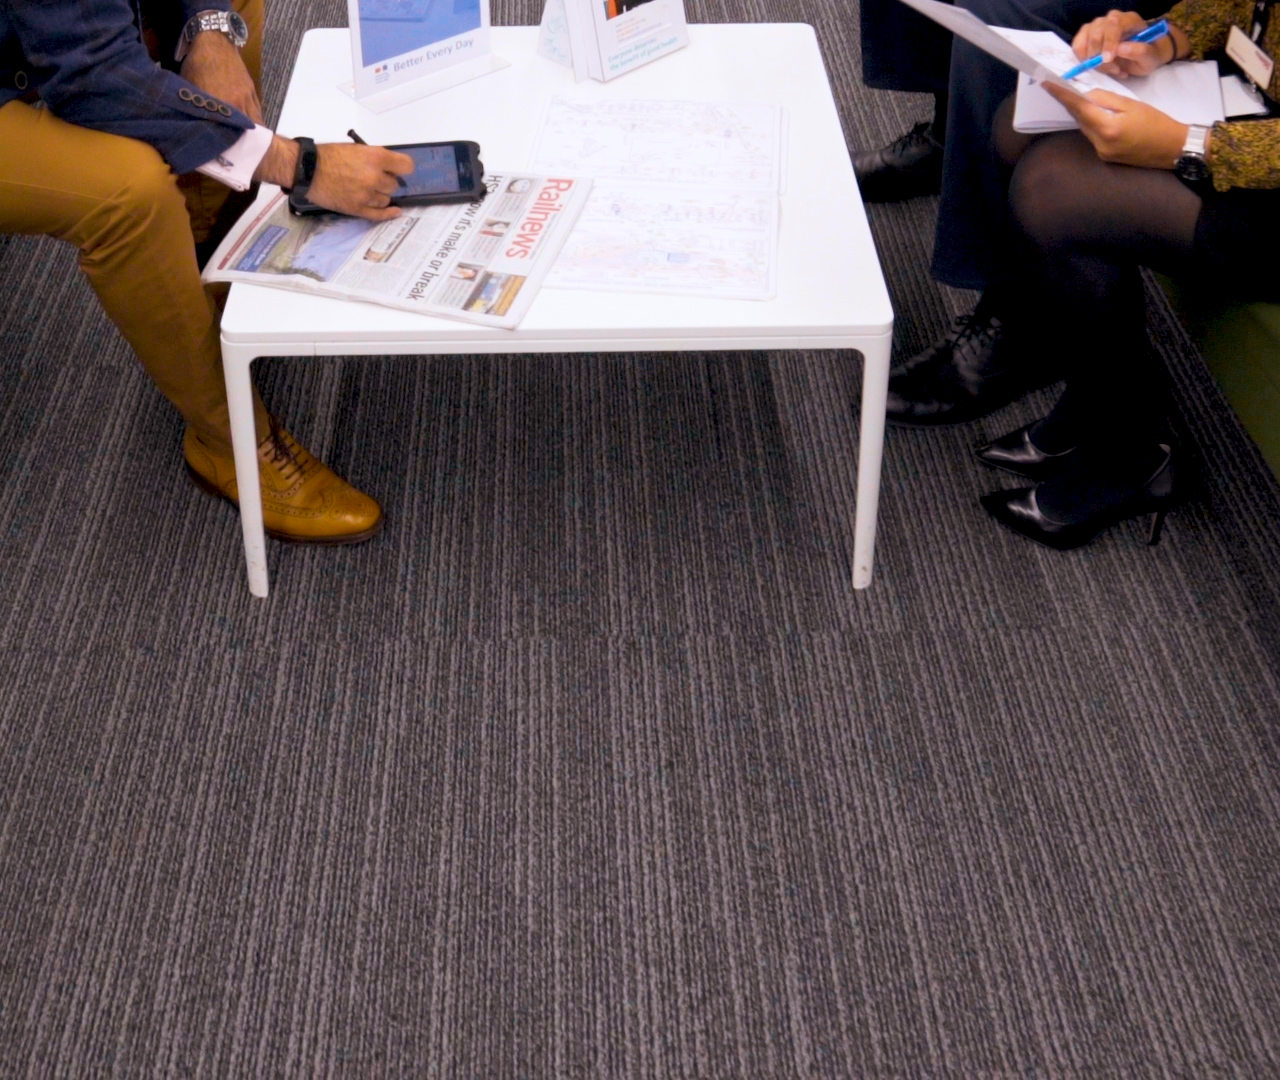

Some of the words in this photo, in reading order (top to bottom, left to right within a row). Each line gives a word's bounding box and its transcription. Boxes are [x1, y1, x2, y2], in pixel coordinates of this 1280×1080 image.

[393, 55, 423, 72] Better
[426, 44, 453, 60] Every
[455, 38, 474, 51] Day
[464, 198, 483, 218] ow
[505, 178, 575, 259] Railnews
[436, 232, 462, 259] make
[428, 259, 443, 271] or
[406, 271, 440, 301] break
